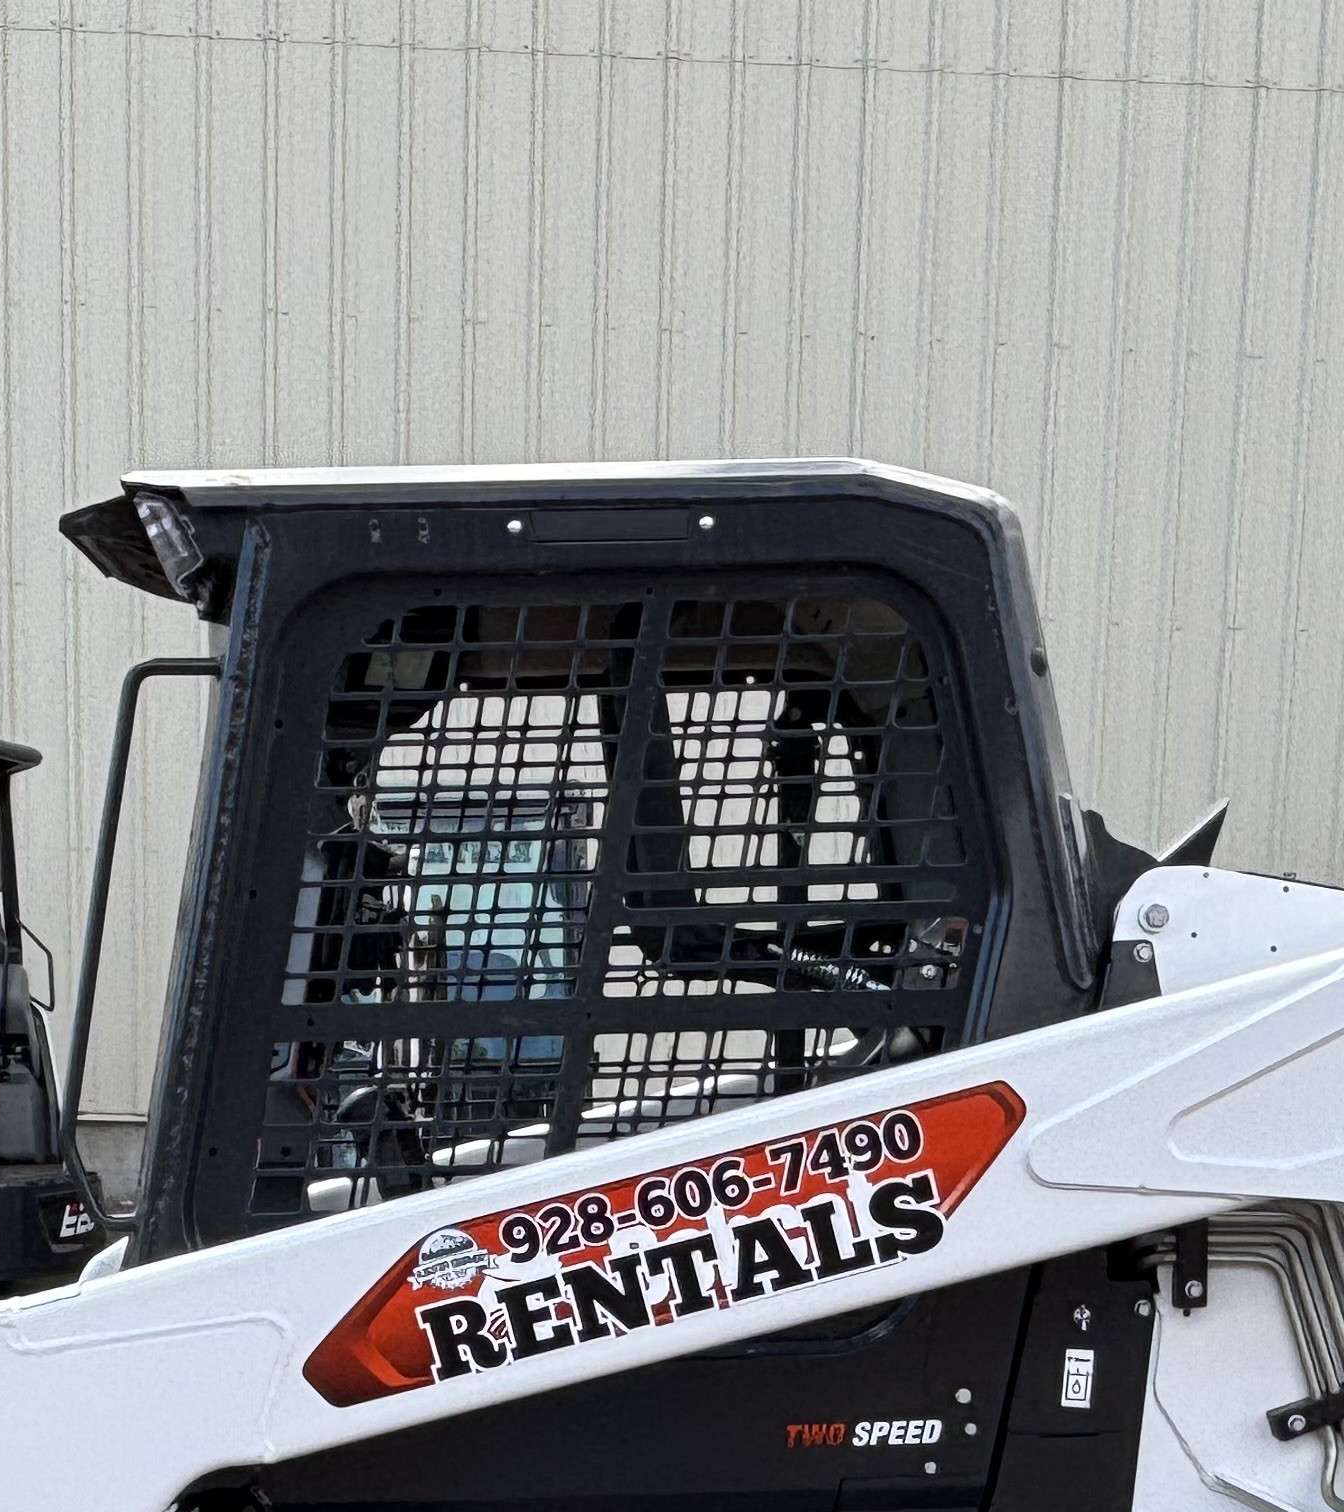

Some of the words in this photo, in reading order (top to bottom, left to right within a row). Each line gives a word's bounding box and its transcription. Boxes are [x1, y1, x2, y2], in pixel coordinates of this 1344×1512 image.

[500, 1109, 923, 1264] 928-606-7490
[416, 1169, 948, 1383] RENTALS
[786, 1421, 847, 1449] TWO
[852, 1419, 943, 1447] SPEED
